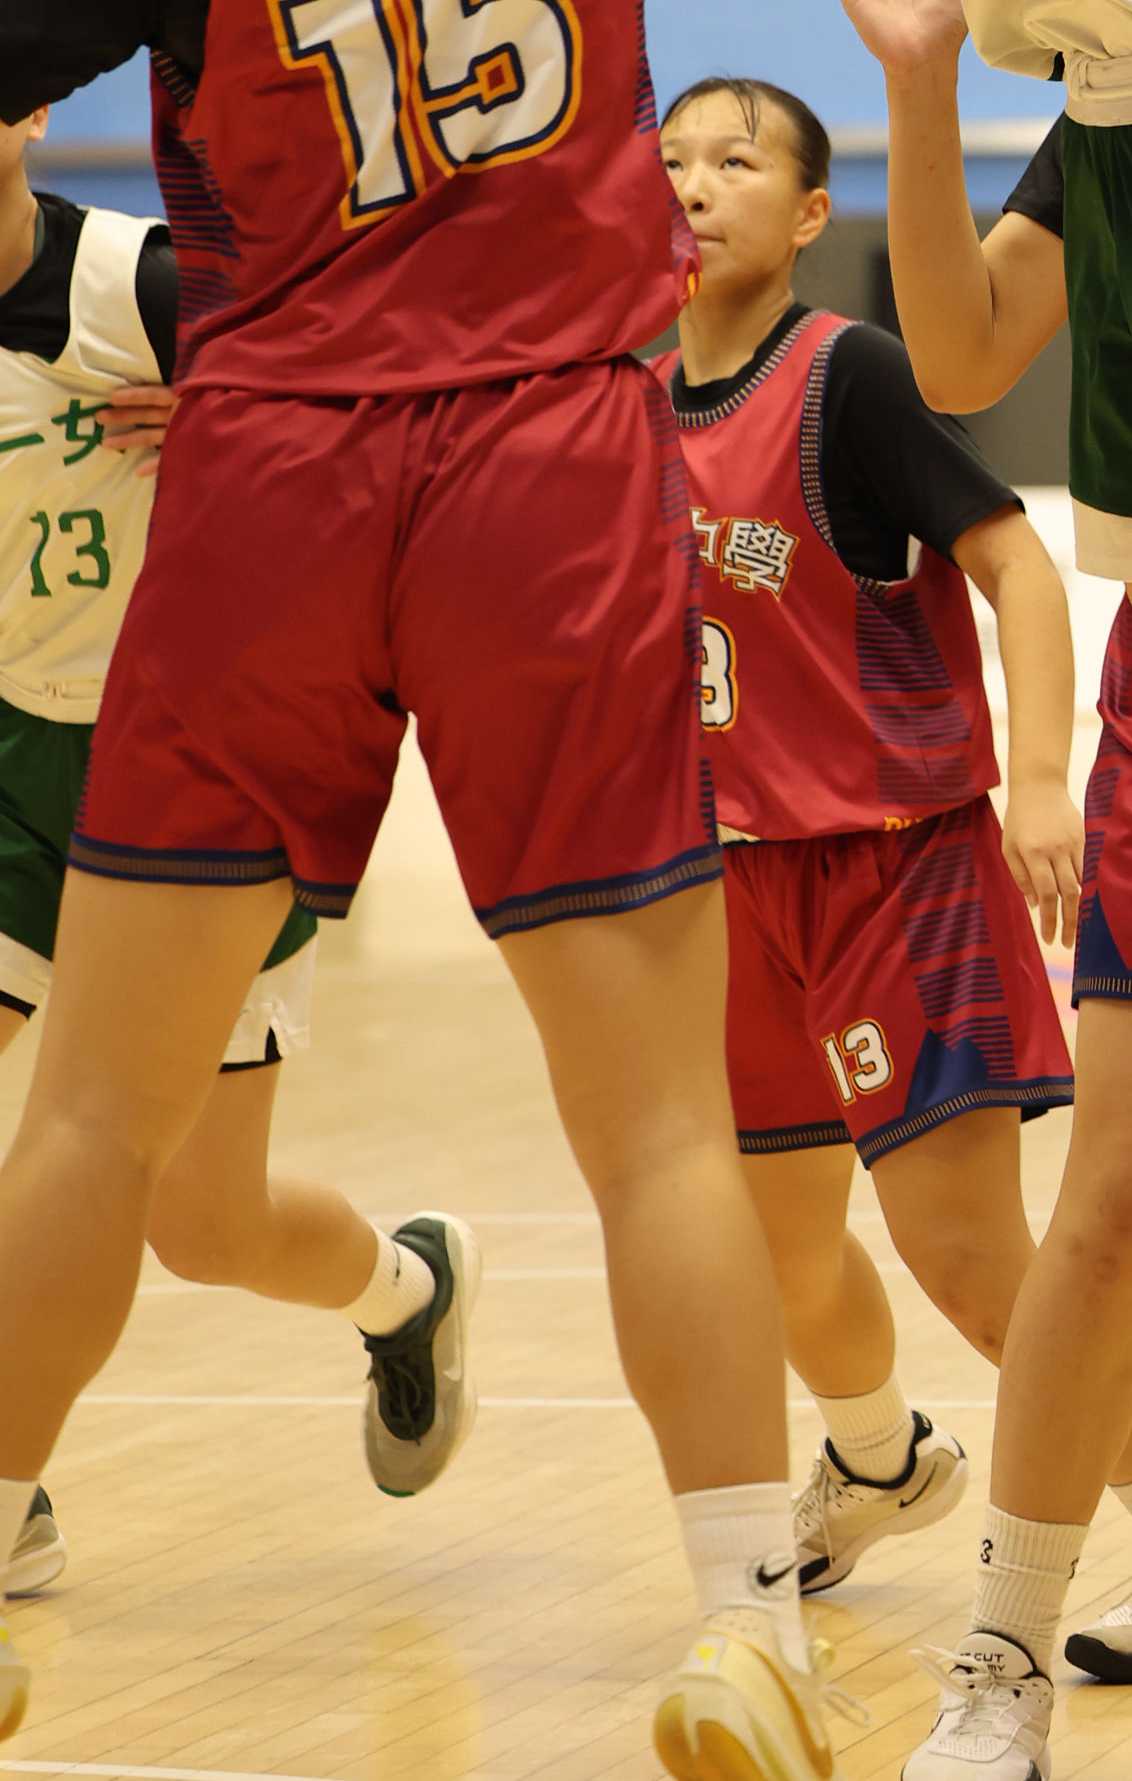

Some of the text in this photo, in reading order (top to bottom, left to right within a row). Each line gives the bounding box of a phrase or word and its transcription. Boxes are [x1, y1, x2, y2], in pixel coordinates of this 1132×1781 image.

[30, 508, 110, 597] 13
[820, 1018, 894, 1106] 13
[974, 1652, 1005, 1662] CUT
